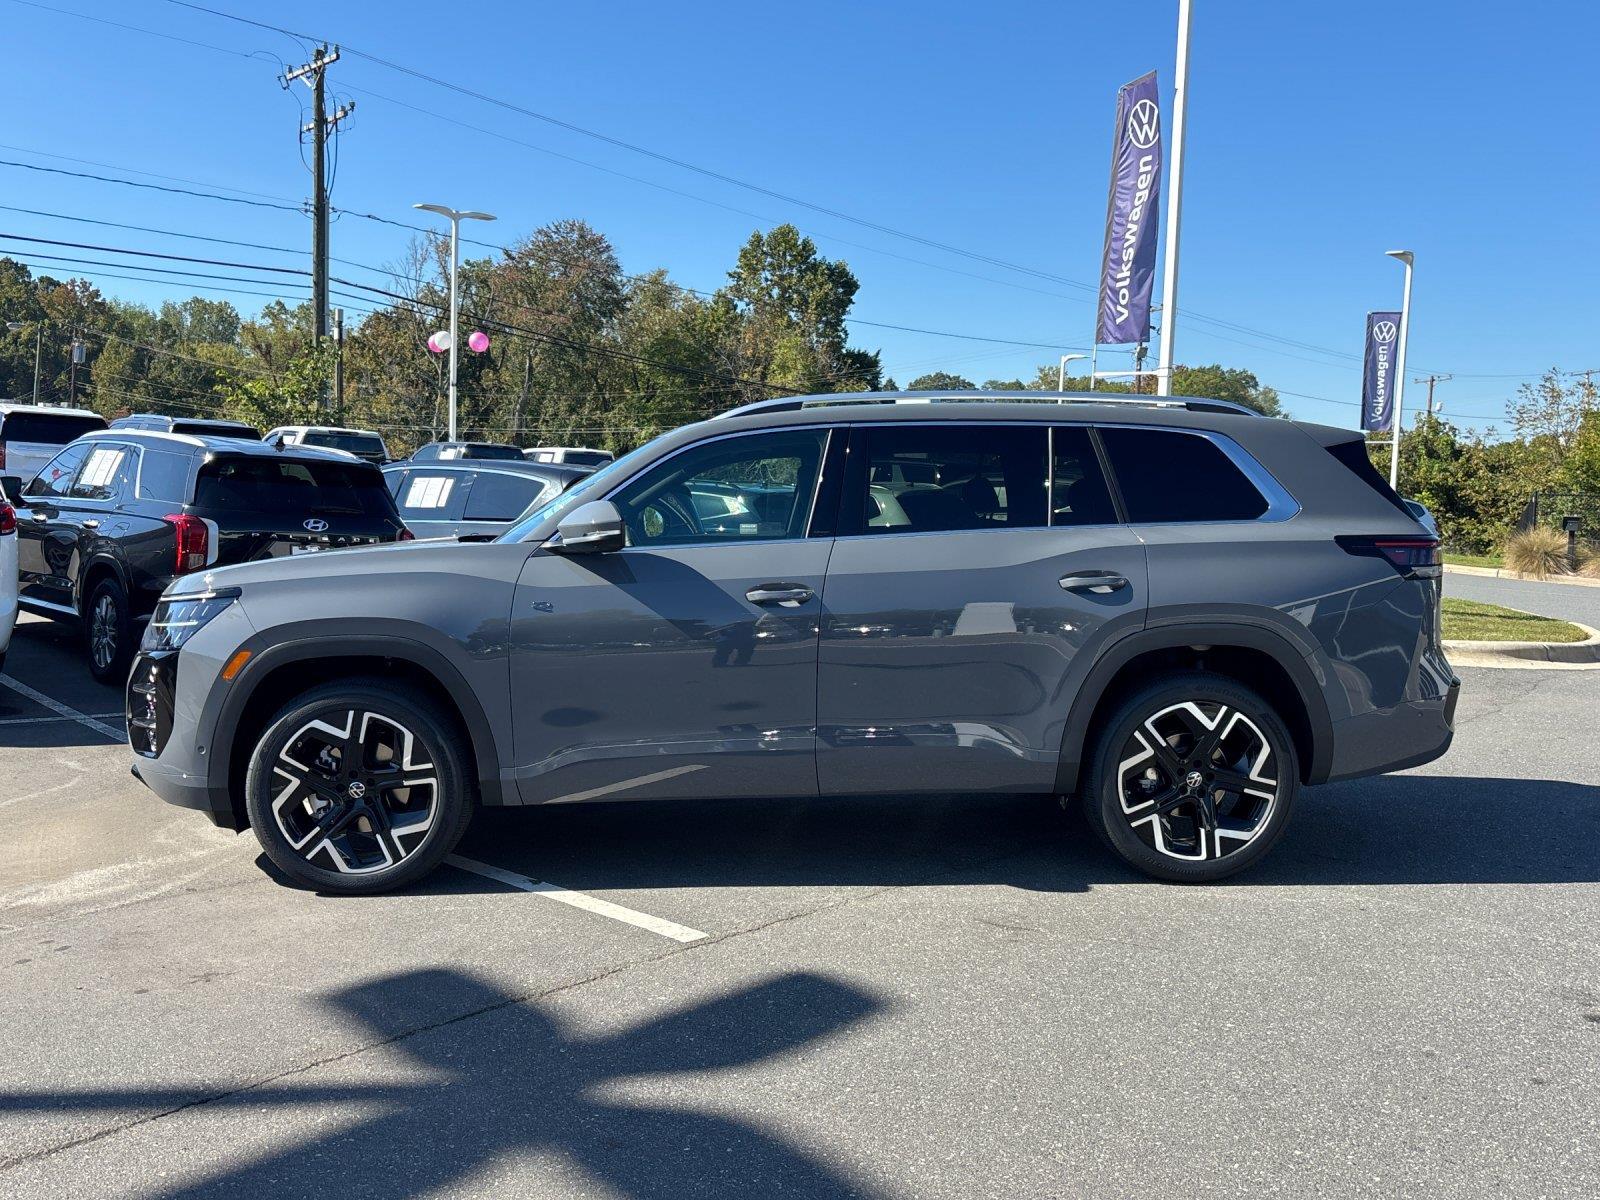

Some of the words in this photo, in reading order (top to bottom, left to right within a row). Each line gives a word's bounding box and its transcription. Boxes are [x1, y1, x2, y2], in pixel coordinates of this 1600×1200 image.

[1116, 155, 1152, 325] Volkswagen
[1373, 321, 1396, 343] VW
[1371, 345, 1388, 422] Volkswagen
